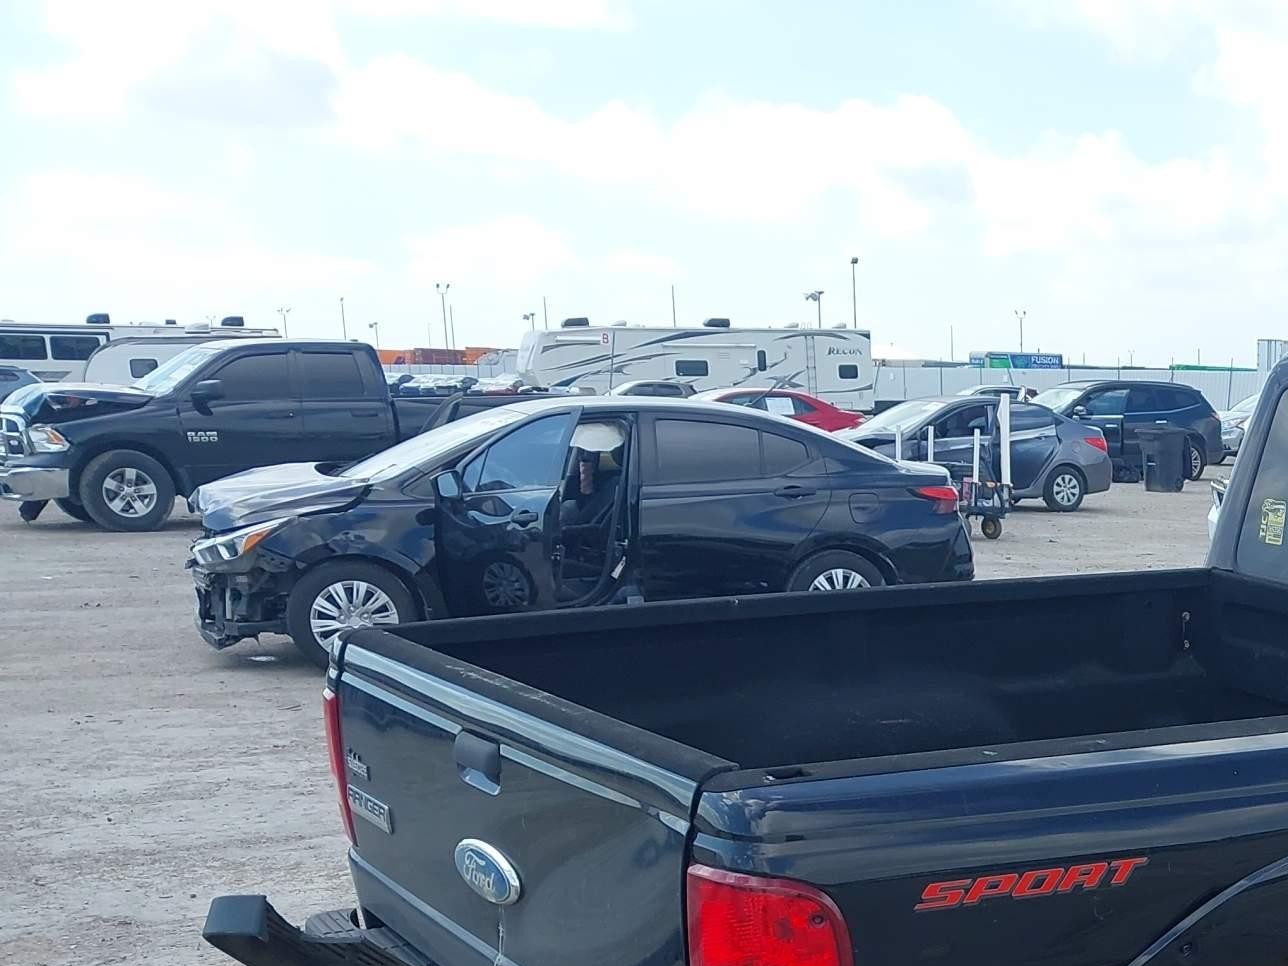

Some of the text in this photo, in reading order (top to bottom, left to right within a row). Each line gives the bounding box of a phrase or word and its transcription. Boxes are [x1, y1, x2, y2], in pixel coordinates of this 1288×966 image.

[1031, 355, 1059, 365] FUSION
[347, 785, 387, 821] RANGER
[463, 850, 496, 893] Ford
[913, 857, 1149, 913] SPORT
